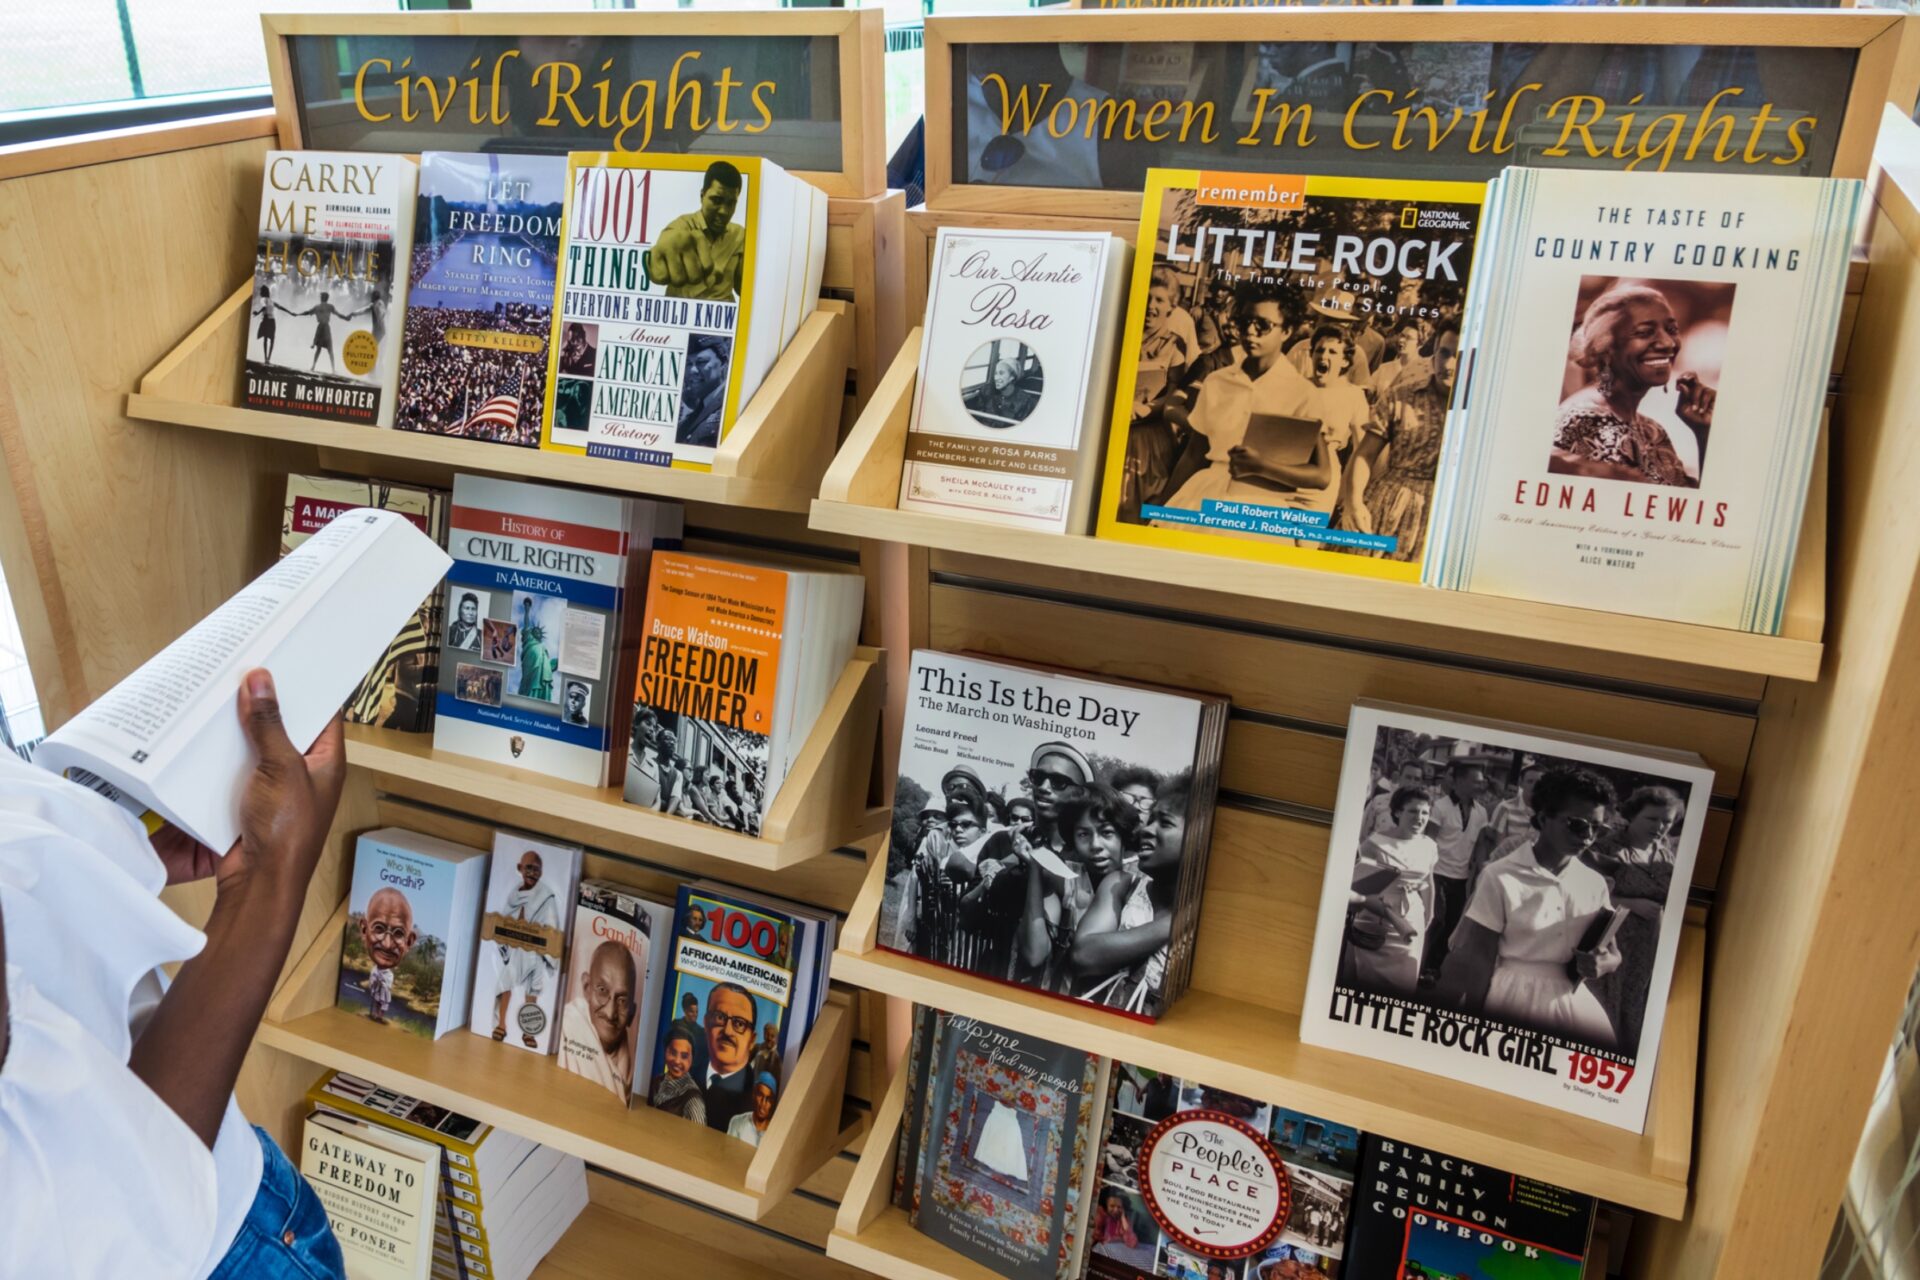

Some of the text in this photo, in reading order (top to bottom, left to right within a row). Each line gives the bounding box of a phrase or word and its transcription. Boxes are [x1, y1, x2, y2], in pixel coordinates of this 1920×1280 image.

[354, 50, 777, 152] Civil Rights
[981, 73, 1818, 171] Women In Civil Rights
[270, 156, 383, 195] CARRY
[487, 181, 530, 201] LET
[366, 206, 391, 214] ALABAMA
[572, 167, 652, 244] 1001
[1200, 183, 1300, 204] remember
[265, 199, 317, 235] ME
[449, 210, 562, 237] FREEDOM
[1418, 218, 1471, 230] GEOGRAPHIC
[1419, 210, 1460, 221] NATIONAL
[1598, 207, 1745, 229] THE TASTE OF
[264, 240, 380, 283] HOME
[472, 244, 532, 268] RING
[569, 245, 652, 292] THINGS
[949, 249, 1083, 284] Our Auntie
[1166, 224, 1463, 282] LITTLE ROCK
[1535, 237, 1800, 271] COUNTRY COOKING
[417, 280, 510, 297] IMAGES OF THE MARCH
[444, 270, 480, 281] STANLEY
[1217, 268, 1241, 283] The
[1300, 276, 1325, 289] the
[564, 291, 737, 329] EVERYONE SHOULD KNOW
[960, 283, 1053, 330] Rosa
[1320, 296, 1441, 319] the Stories
[452, 329, 537, 348] KITTY KELLEY
[619, 327, 671, 345] About
[597, 343, 683, 387] AFRICAN
[249, 378, 375, 409] DIANE McWHORTER
[594, 385, 679, 423] AMERICAN
[601, 421, 661, 445] History
[928, 440, 1058, 461] THE FAMILY OF ROSA PARKS
[588, 444, 620, 459] JEFFREY
[634, 451, 671, 464] STEWART
[916, 450, 1067, 474] REMEMBERS HER LIFE AND LESSONS
[940, 475, 969, 486] SHEILA
[1016, 484, 1037, 495] KEYS
[1215, 501, 1321, 525] Paul Robert Walker
[1515, 480, 1728, 528] EDNA LEWIS
[501, 516, 565, 540] HISTORY OF
[1198, 513, 1306, 538] Terrence J. Roberts,
[467, 537, 595, 576] CIVIL RIGHTS
[1580, 555, 1636, 570] ALICE WATERS
[495, 571, 563, 594] IN AMERICA
[652, 618, 728, 650] Bruce Watson
[643, 634, 759, 696] FREEDOM
[637, 672, 747, 730] SUMMER
[917, 666, 1140, 737] This Is the Day
[918, 696, 1096, 741] The March on Washington
[915, 723, 951, 738] Leonard
[953, 731, 978, 743] Freed
[380, 868, 425, 890] Gandhi?
[592, 915, 643, 956] Gandhi
[706, 906, 777, 957] 100
[680, 945, 788, 988] AFRICAN-AMERICANS
[680, 956, 785, 995] WHO SHAPED AMERICAN HISTORY
[946, 1015, 989, 1043] help
[1335, 986, 1355, 997] HOW
[1369, 994, 1432, 1013] PHOTOGRAPH
[1436, 1008, 1480, 1025] CHANGED
[1485, 1020, 1503, 1031] THE
[1507, 1026, 1537, 1039] FIGHT
[1542, 1034, 1561, 1046] FOR
[1565, 1040, 1636, 1066] INTEGRATION
[1329, 994, 1635, 1094] LITTLE ROCK GIRL 1957
[988, 1047, 1020, 1067] find
[1018, 1062, 1039, 1080] my
[1039, 1072, 1081, 1093] people
[1173, 1131, 1265, 1178] People's
[1203, 1130, 1224, 1147] The
[309, 1137, 414, 1188] GATEWAY TO
[1381, 1140, 1475, 1178] BLACK
[318, 1161, 401, 1203] FREEDOM
[1163, 1178, 1260, 1214] SOUL FOOD RESTAURANTS
[1171, 1161, 1259, 1199] PLACE
[1378, 1160, 1485, 1201] FAMILY
[1161, 1187, 1260, 1223] AND REMINISCENCES FROM
[1166, 1196, 1252, 1229] THE CIVIL RIGHTS ERA
[1189, 1212, 1225, 1229] TO TODAY
[1375, 1180, 1508, 1229] REUNION
[350, 1227, 396, 1253] FONER
[1372, 1200, 1540, 1260] COOKBOOK
